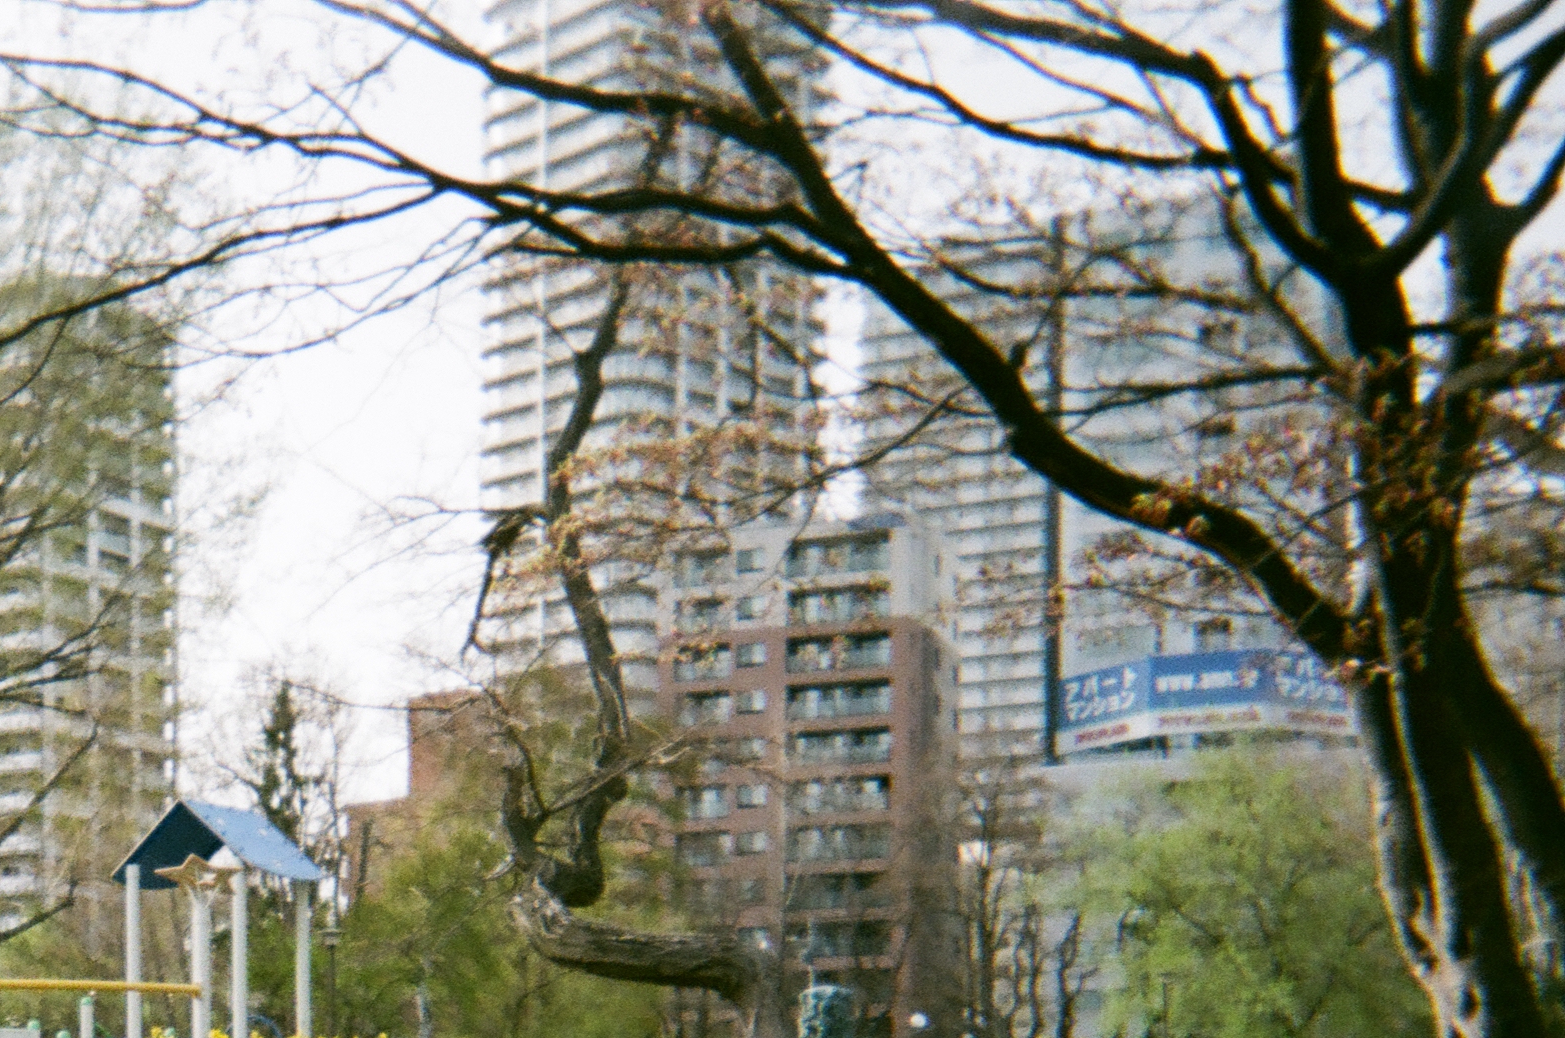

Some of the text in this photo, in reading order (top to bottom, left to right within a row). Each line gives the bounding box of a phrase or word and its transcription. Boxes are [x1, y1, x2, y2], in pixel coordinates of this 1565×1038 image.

[1064, 667, 1137, 702] アパート
[1065, 691, 1135, 722] マンション
